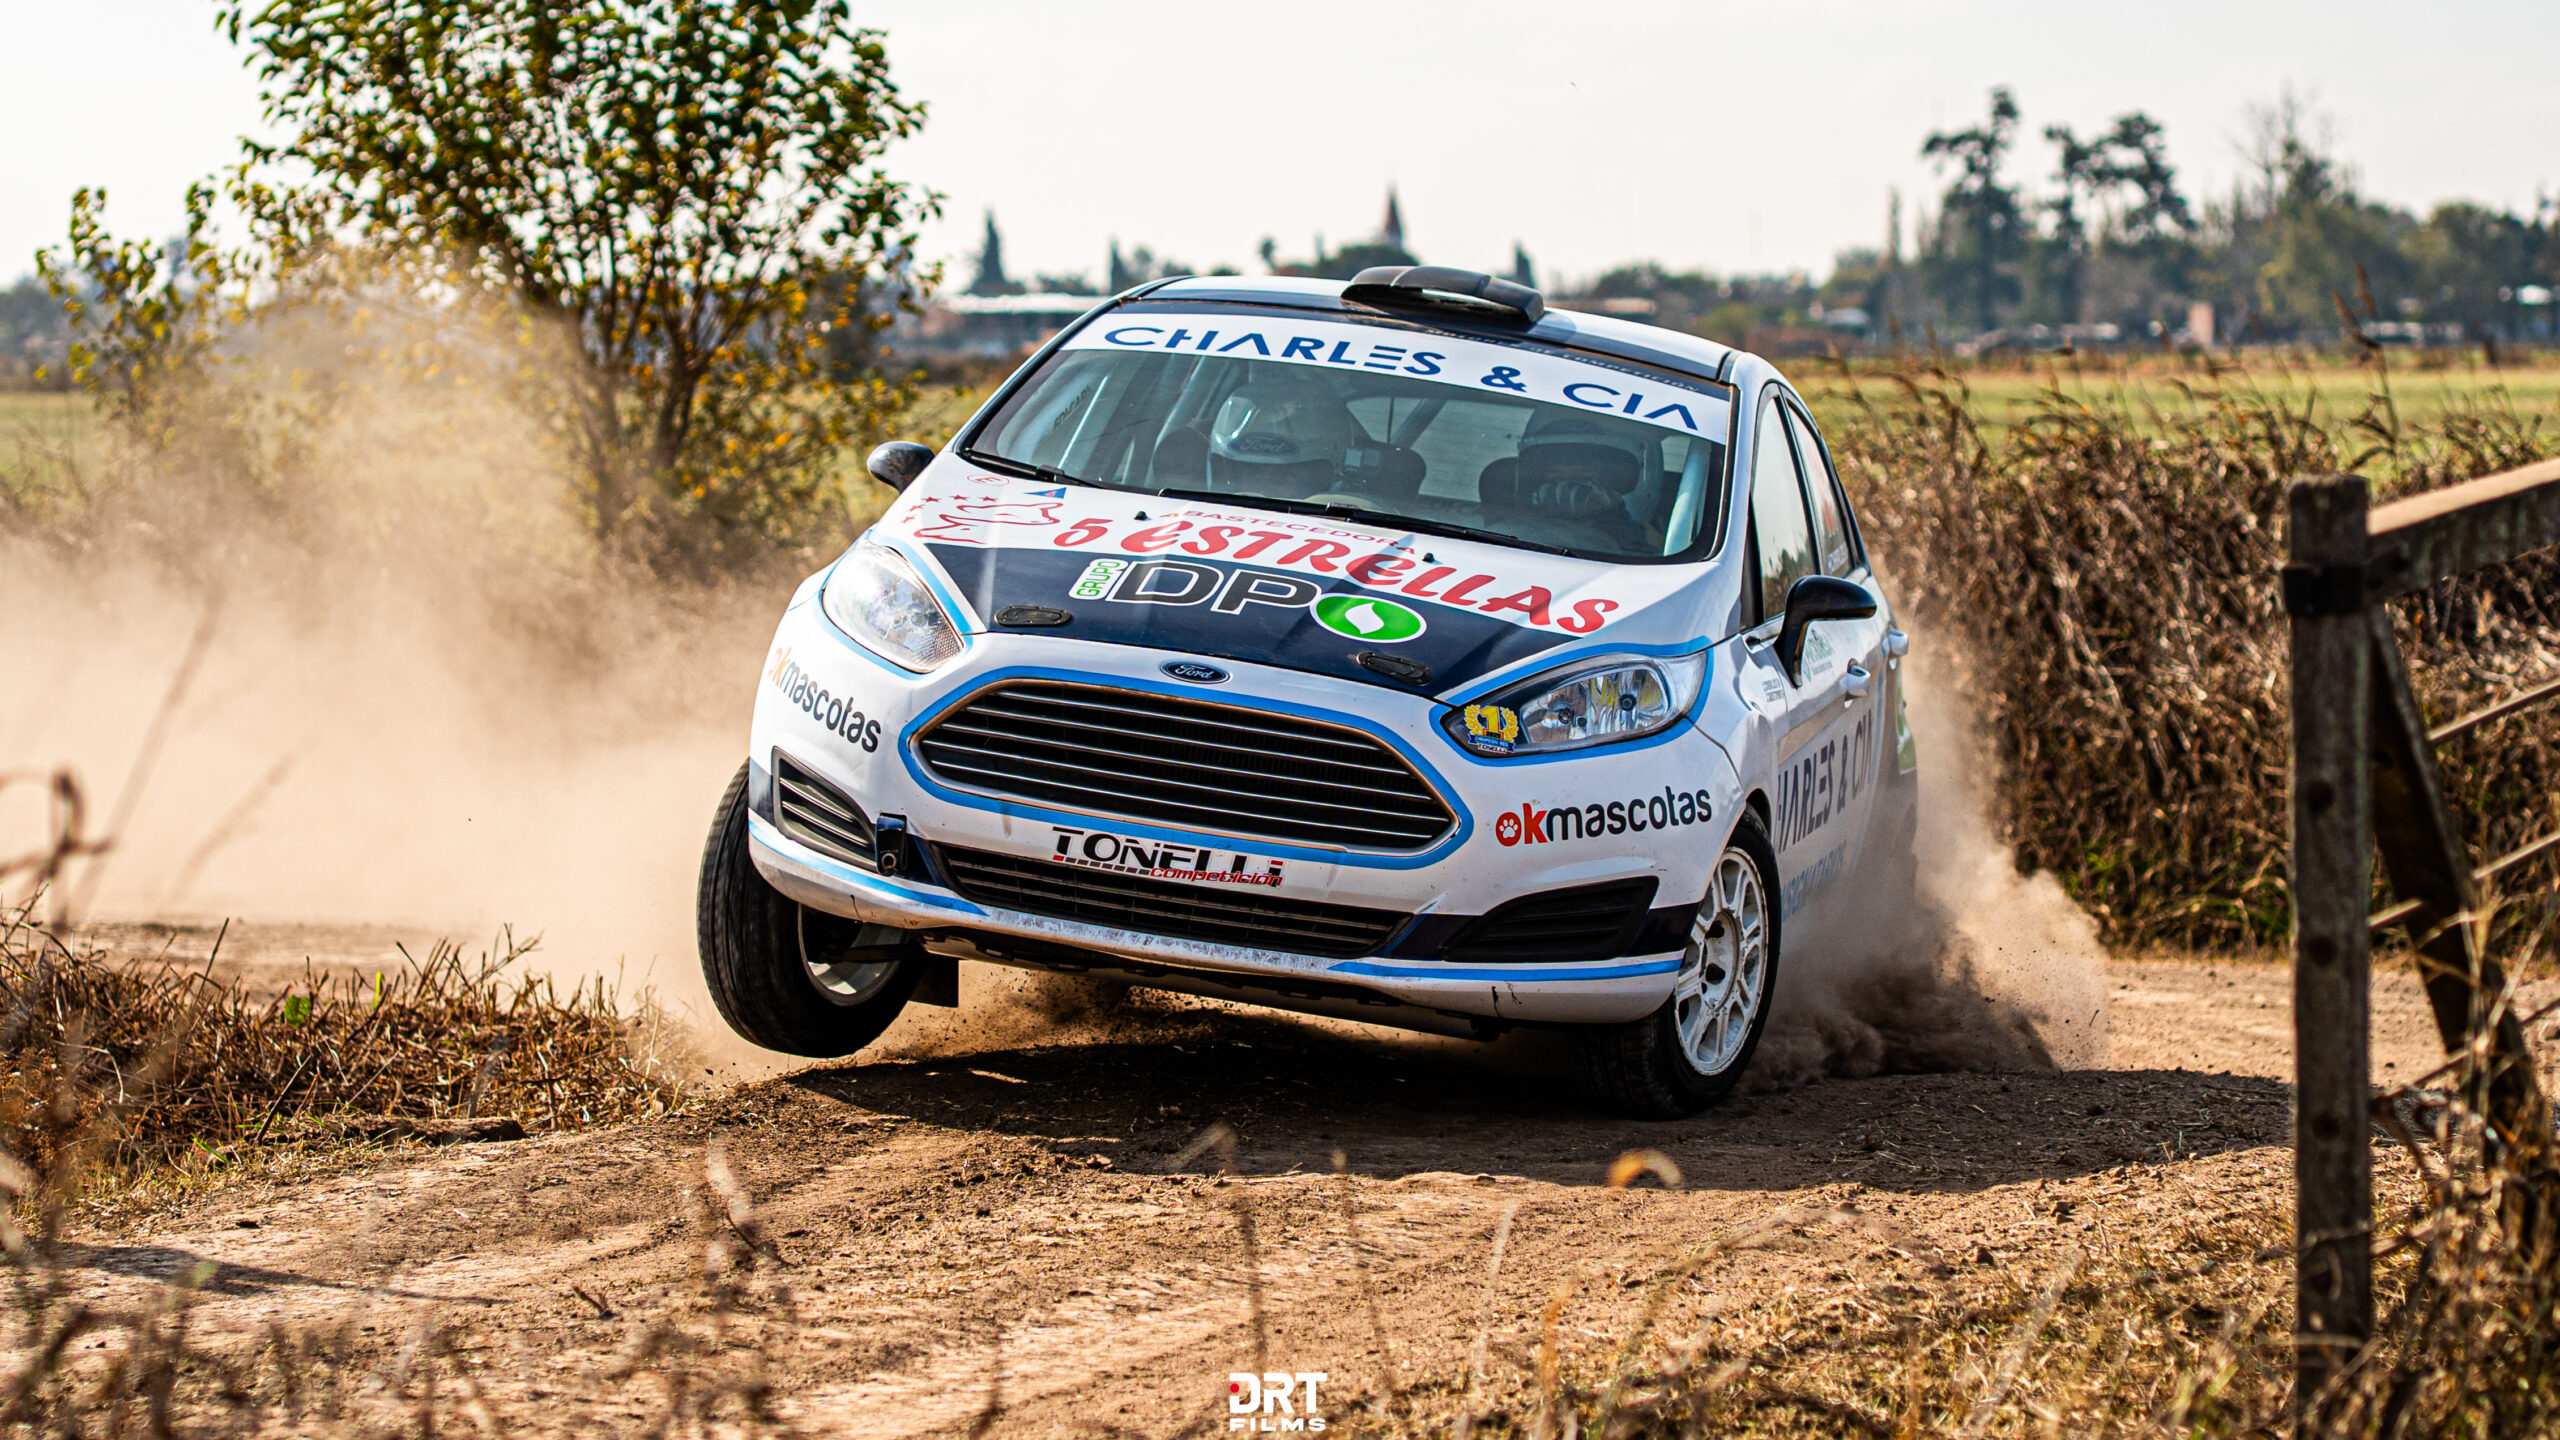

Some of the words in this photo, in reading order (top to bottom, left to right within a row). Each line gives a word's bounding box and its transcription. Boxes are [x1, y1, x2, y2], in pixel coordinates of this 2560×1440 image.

[1105, 327, 1446, 375] CHARLES
[1480, 366, 1527, 392] &
[1563, 383, 1698, 430] CIA
[1054, 518, 1113, 547] 5
[1160, 510, 1415, 554] ABASTECEDORA
[1076, 561, 1121, 597] GRUPO
[1175, 664, 1214, 679] Ford
[1480, 706, 1504, 740] 1
[1837, 735, 1848, 814] &
[1495, 785, 1712, 847] okmascotas
